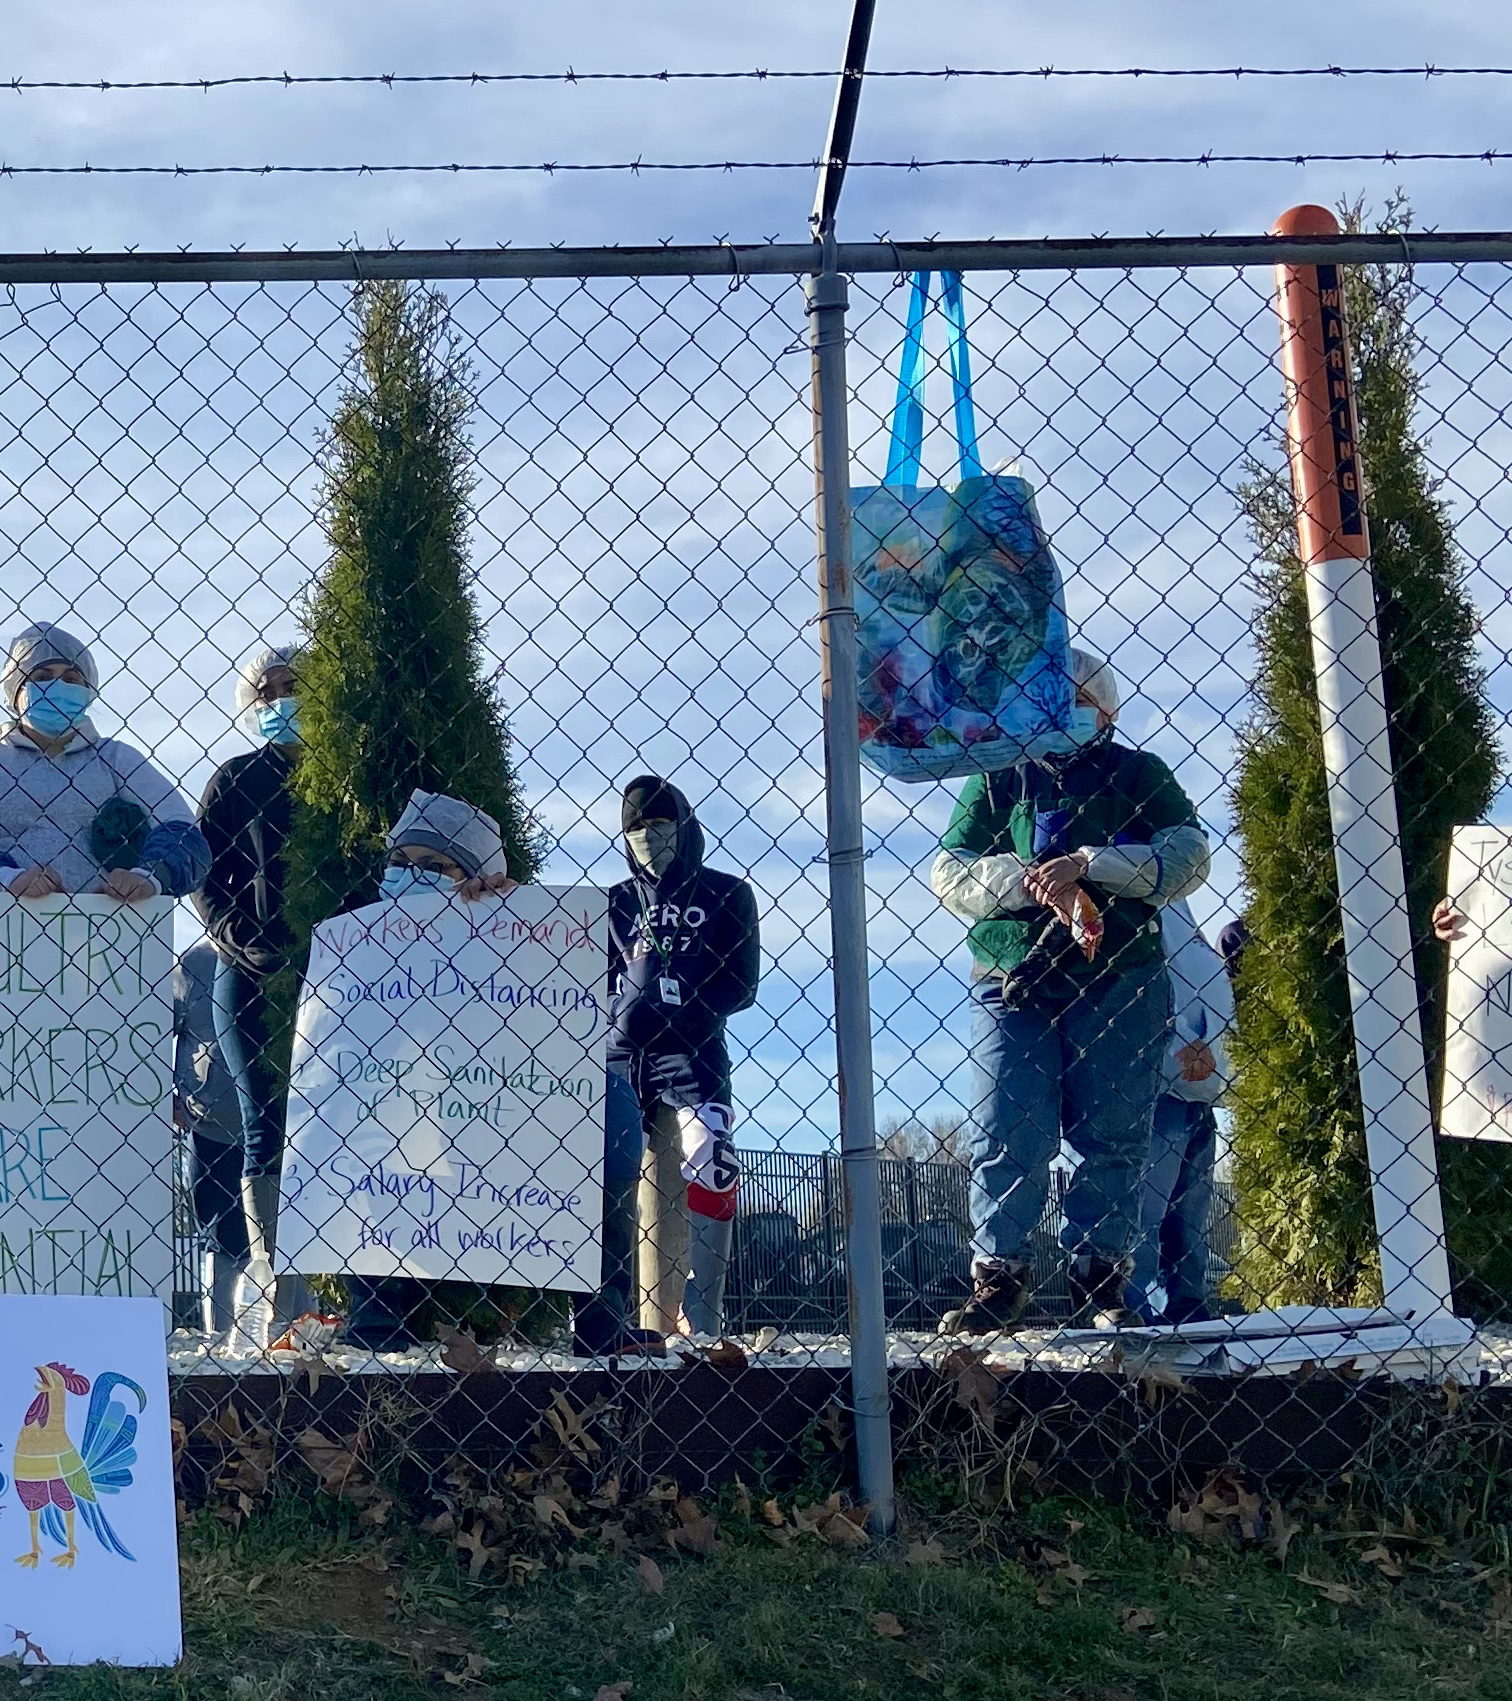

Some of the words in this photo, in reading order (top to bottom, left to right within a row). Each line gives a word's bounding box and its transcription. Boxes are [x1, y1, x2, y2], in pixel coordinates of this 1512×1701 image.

[1321, 289, 1355, 491] WARNING
[316, 909, 444, 958] Workers
[465, 901, 594, 953] Demand
[628, 903, 705, 937] AERO
[325, 966, 416, 1009] Social
[429, 959, 598, 1041] Distancing
[337, 1050, 414, 1096] Deep
[425, 1046, 593, 1102] Sanitation
[356, 1089, 385, 1121] of
[409, 1089, 515, 1127] Plant
[327, 1156, 435, 1216] Salary
[448, 1161, 582, 1212] Increase
[358, 1223, 394, 1249] for
[411, 1221, 440, 1248] all
[458, 1223, 575, 1265] workers
